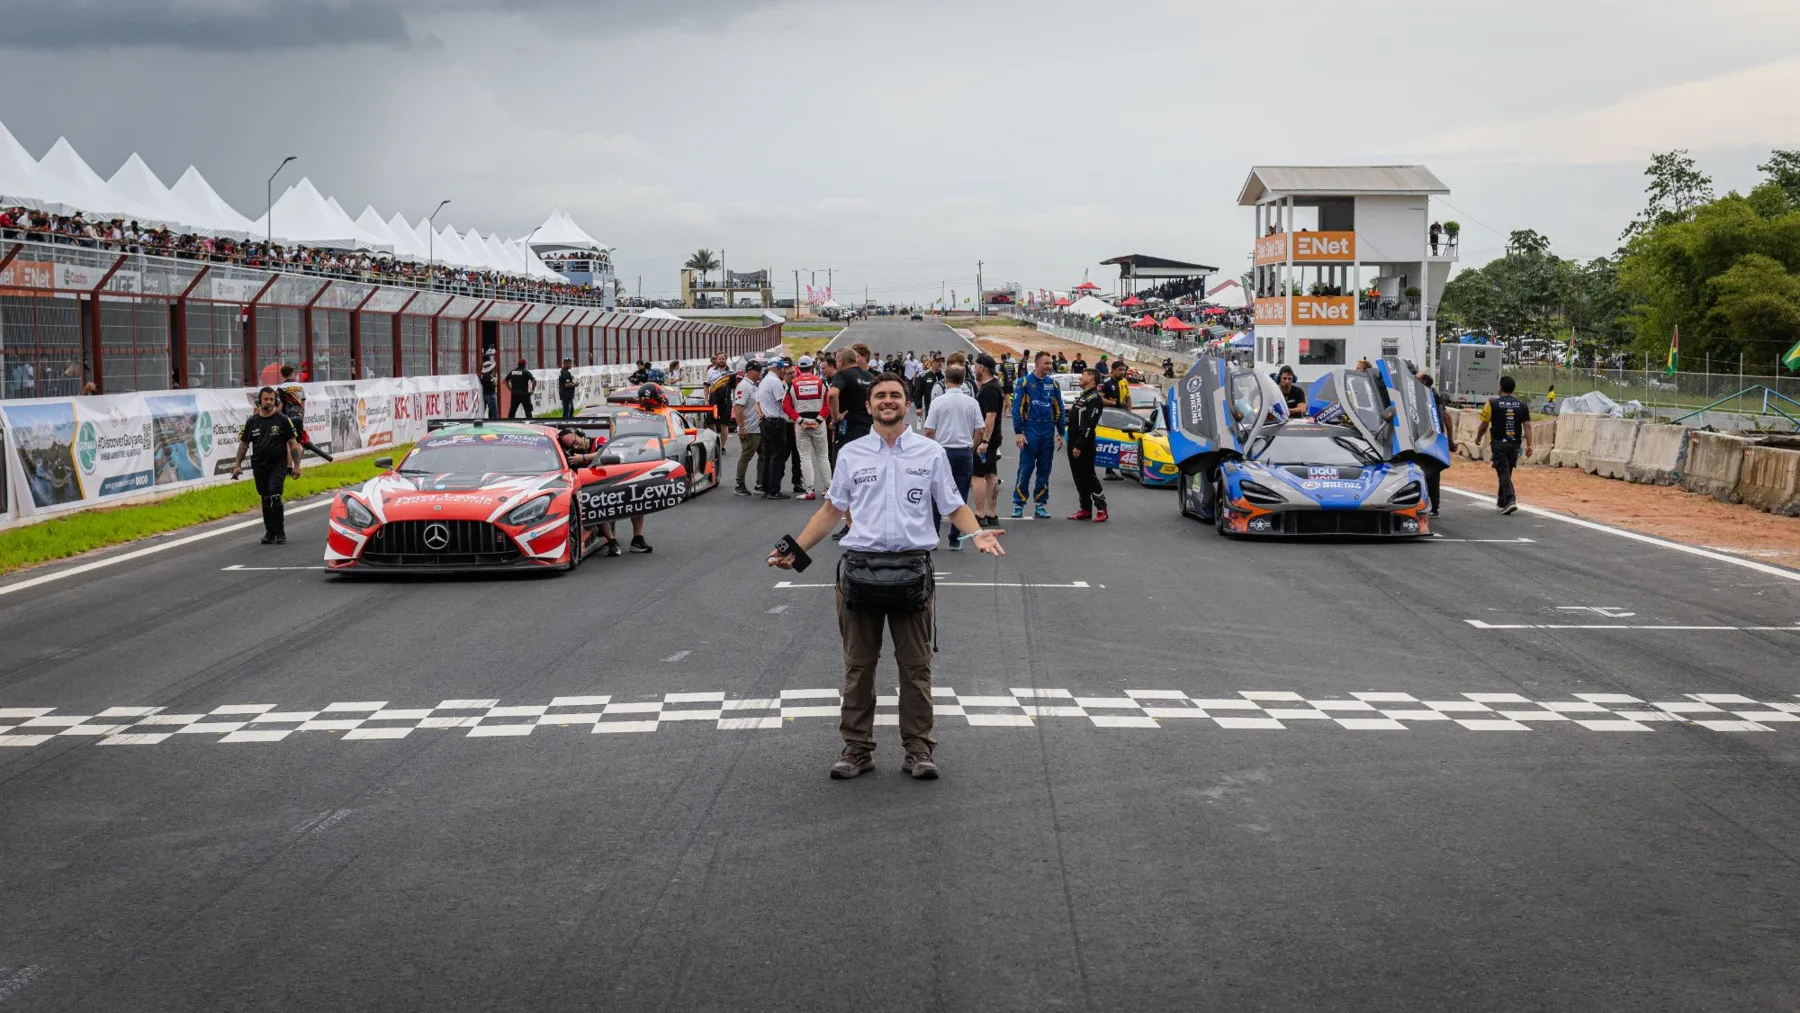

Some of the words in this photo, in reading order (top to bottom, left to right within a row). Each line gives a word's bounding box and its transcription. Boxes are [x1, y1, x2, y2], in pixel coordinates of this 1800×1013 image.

[1298, 237, 1349, 255] ENet
[1298, 301, 1349, 319] ENet
[395, 396, 410, 420] KFC
[426, 394, 440, 416] KFC
[456, 391, 469, 412] KFC
[1096, 443, 1119, 454] arts
[1310, 468, 1337, 476] LIQUI
[577, 489, 626, 508] Peter
[629, 479, 686, 502] Lewis
